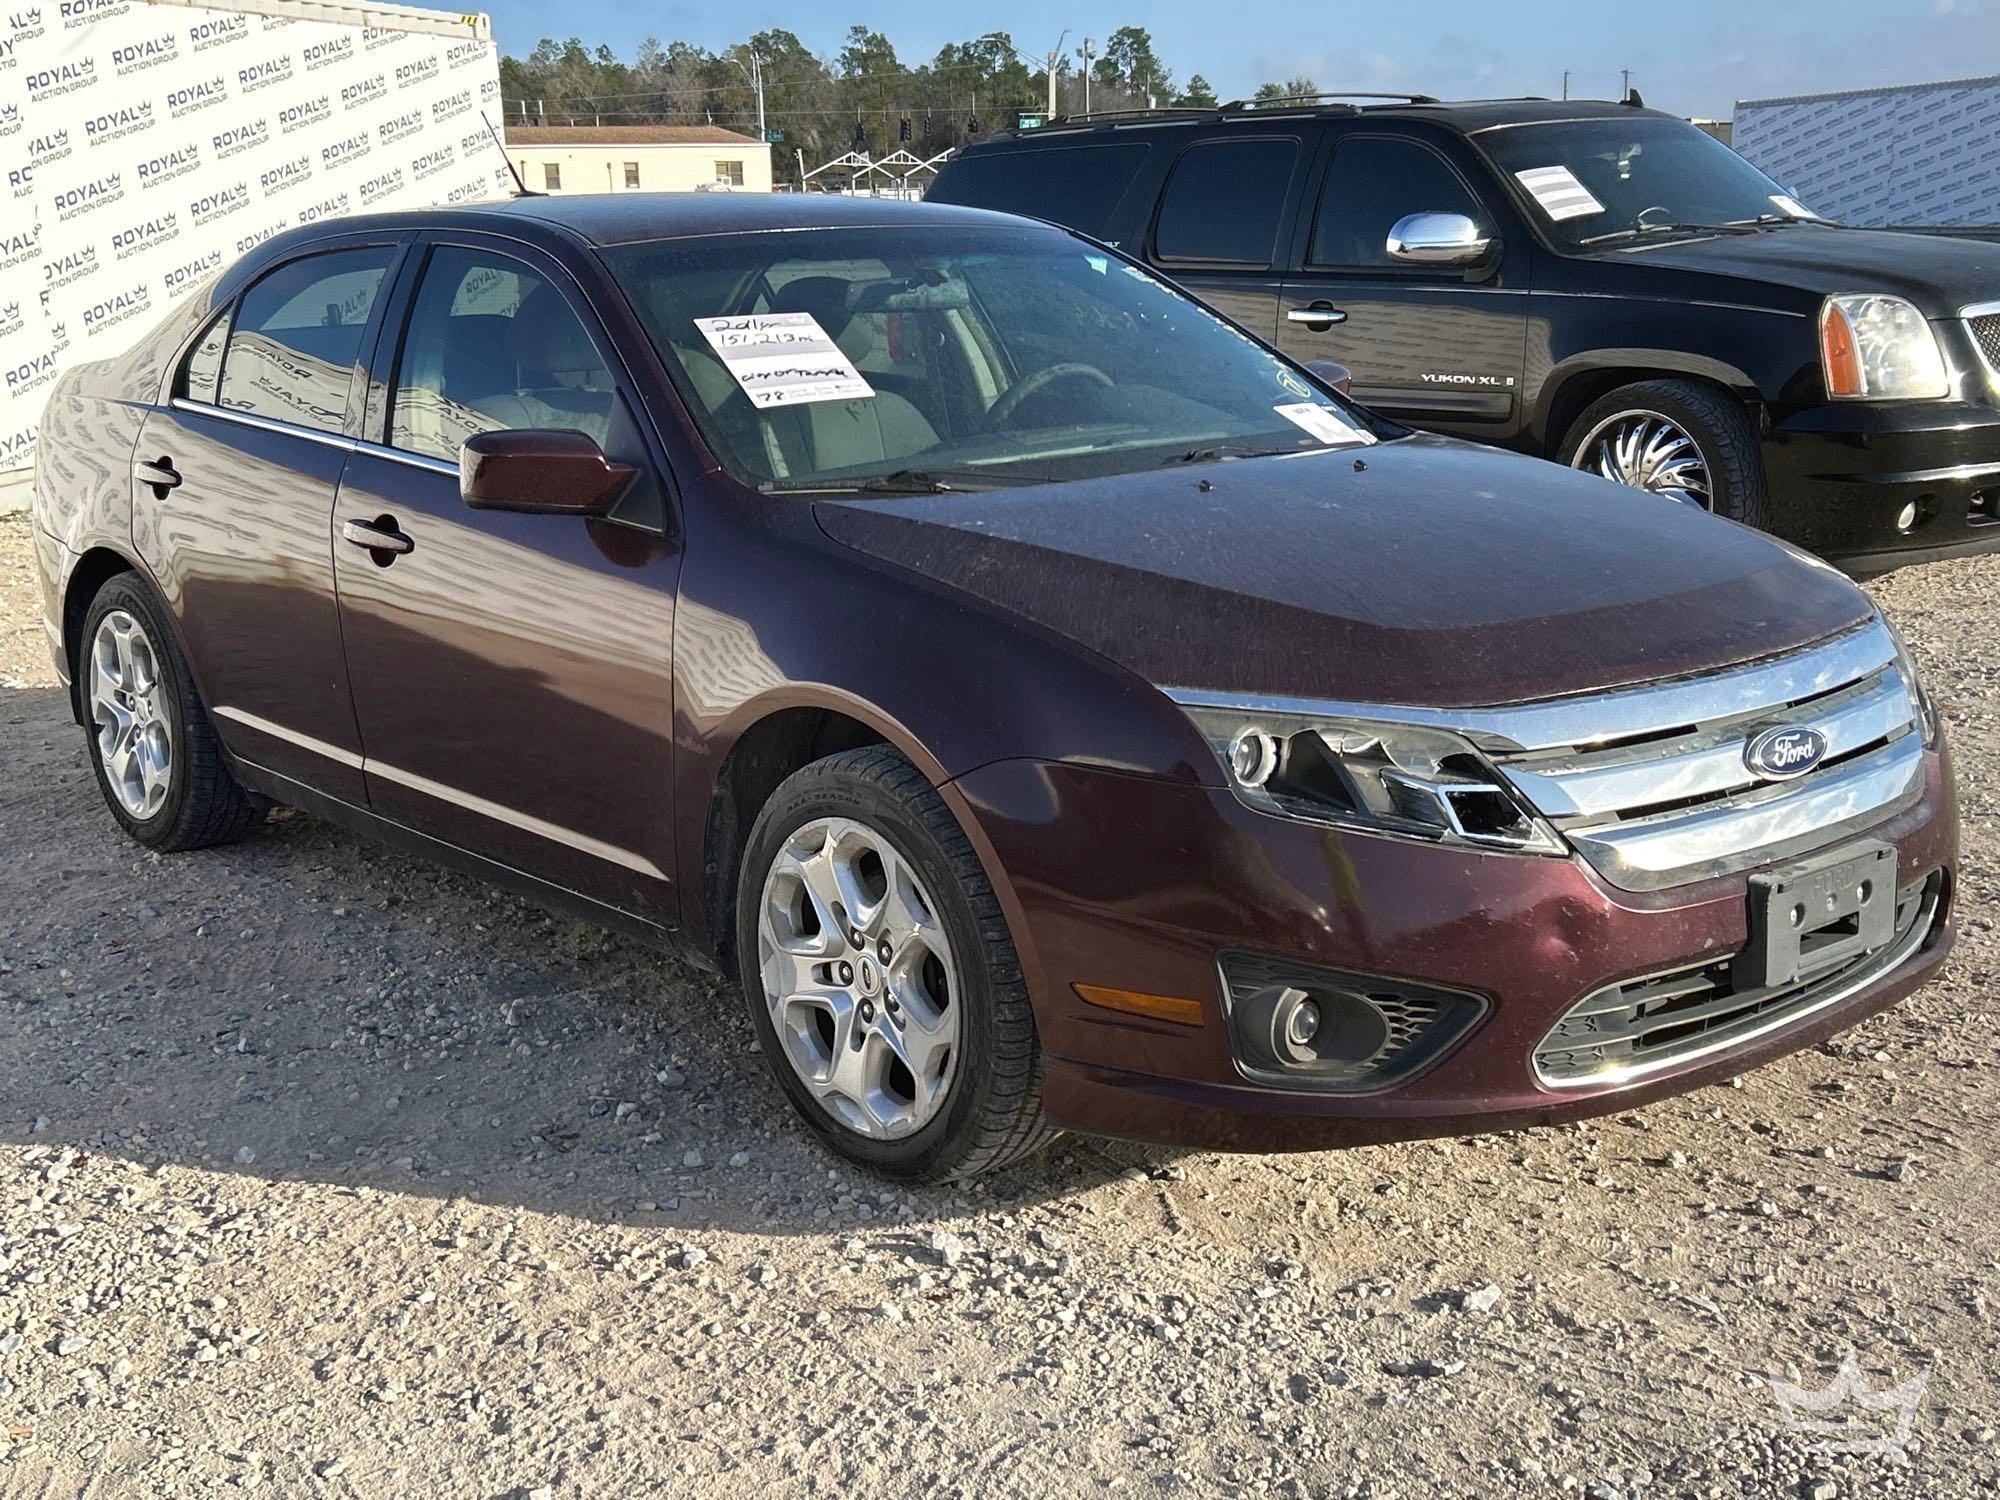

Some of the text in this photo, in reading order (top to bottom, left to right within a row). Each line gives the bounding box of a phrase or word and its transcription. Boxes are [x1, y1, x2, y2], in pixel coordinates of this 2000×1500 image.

[65, 5, 130, 30] AUCTION GROUP
[190, 18, 235, 42] ROYAL
[15, 27, 45, 42] GROUP
[194, 30, 249, 53] AUCTION GROUP
[112, 39, 164, 65] ROYAL
[117, 51, 179, 76] AUCTION GROUP
[303, 40, 343, 62] ROYAL
[446, 42, 479, 61] ROYAL
[26, 63, 81, 91] ROYAL
[238, 60, 280, 84] ROYAL
[306, 58, 333, 72] AUCTION
[395, 59, 430, 80] ROYAL
[32, 75, 98, 103] AUCTION GROUP
[167, 82, 214, 108] ROYAL
[242, 71, 293, 94] AUCTION GROUP
[341, 78, 377, 101] ROYAL
[480, 79, 500, 95] ROY
[172, 93, 228, 119] AUCTION GROUP
[279, 100, 320, 124] ROYAL
[432, 94, 464, 115] ROYAL
[85, 108, 140, 136] ROYAL
[90, 119, 155, 148] AUCTION GROUP
[282, 119, 310, 134] AUCTION
[379, 115, 414, 137] ROYAL
[28, 136, 56, 156] YAL
[212, 124, 257, 150] ROYAL
[217, 134, 270, 160] AUCTION GROUP
[322, 137, 361, 161] ROYAL
[461, 129, 493, 150] ROYAL
[43, 147, 72, 165] GROUP
[137, 150, 187, 179] ROYAL
[412, 149, 446, 173] ROYAL
[142, 160, 202, 190] AUCTION GROUP
[260, 161, 300, 188] ROYAL
[264, 171, 313, 198] AUCTION GROUP
[359, 172, 394, 197] ROYAL
[54, 180, 108, 211] ROYAL
[190, 188, 236, 217] ROYAL
[447, 181, 479, 203] ROYAL
[59, 190, 125, 223] AUCTION GROUP
[195, 198, 251, 228] AUCTION GROUP
[298, 199, 339, 224] ROYAL
[0, 233, 35, 256] YAL
[112, 219, 165, 250] ROYAL
[117, 228, 180, 261] AUCTION GROUP
[50, 262, 100, 290] TION GROUP
[164, 257, 210, 288] ROYAL
[169, 279, 199, 299] AUCTION
[83, 292, 135, 326] ROYAL
[88, 301, 152, 337] AUCTION GROUP
[0, 320, 24, 337] ROUP
[12, 375, 50, 399] AUCTION
[1421, 373, 1502, 386] YUKON XL
[1772, 733, 1815, 767] Ford
